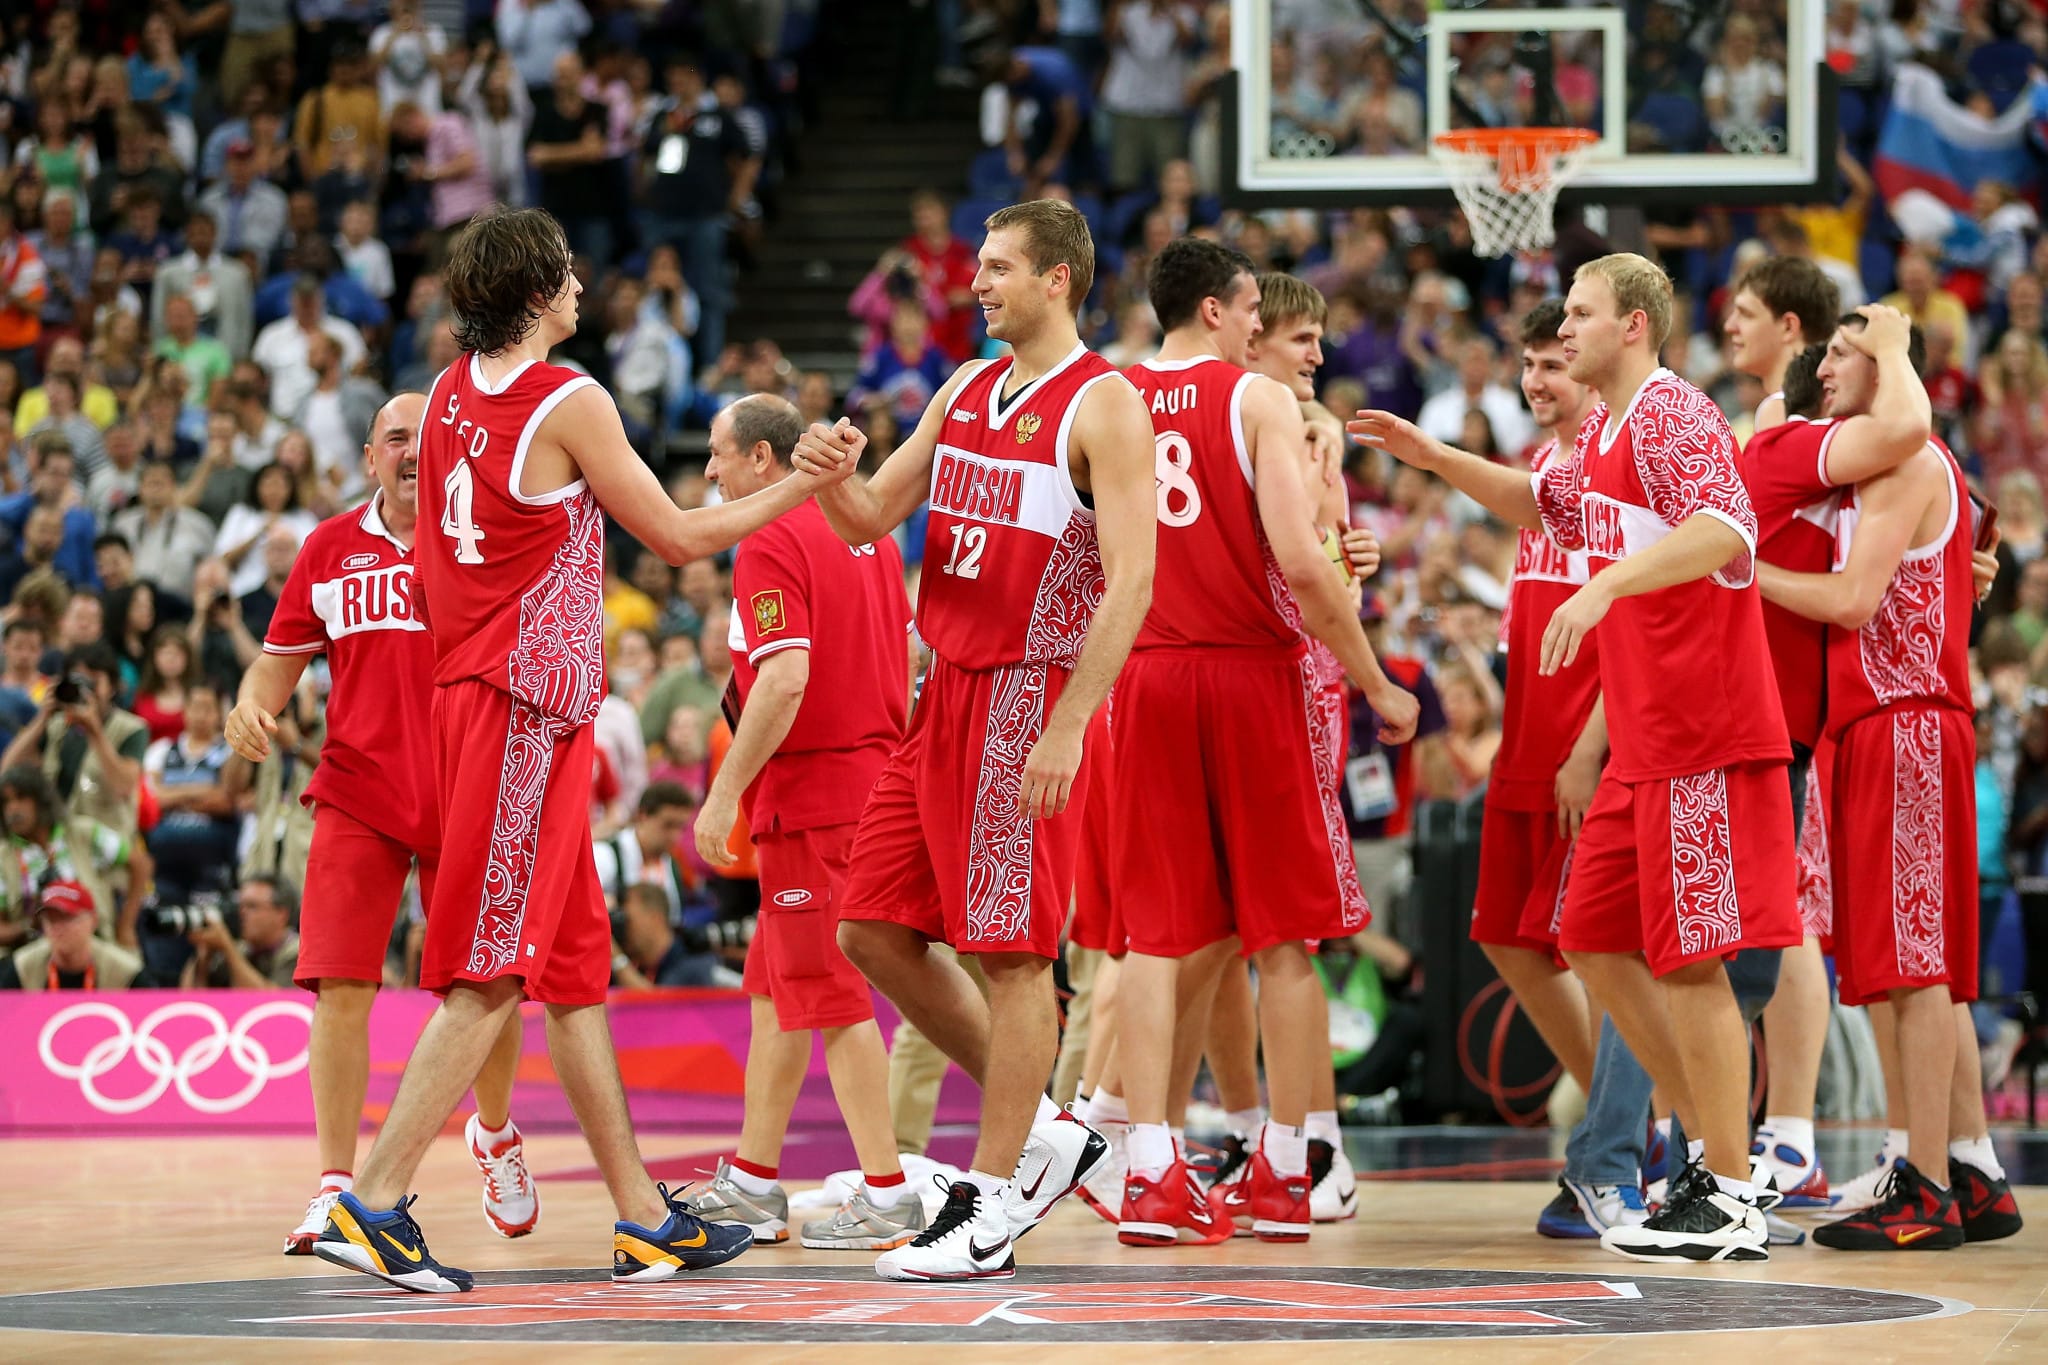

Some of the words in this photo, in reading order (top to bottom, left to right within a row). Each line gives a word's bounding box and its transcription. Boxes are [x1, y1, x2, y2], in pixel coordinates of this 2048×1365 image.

[1139, 383, 1197, 415] AUN
[440, 457, 486, 564] 4
[932, 452, 1025, 525] RUSSIA
[1155, 430, 1202, 528] 8
[942, 523, 988, 580] 12
